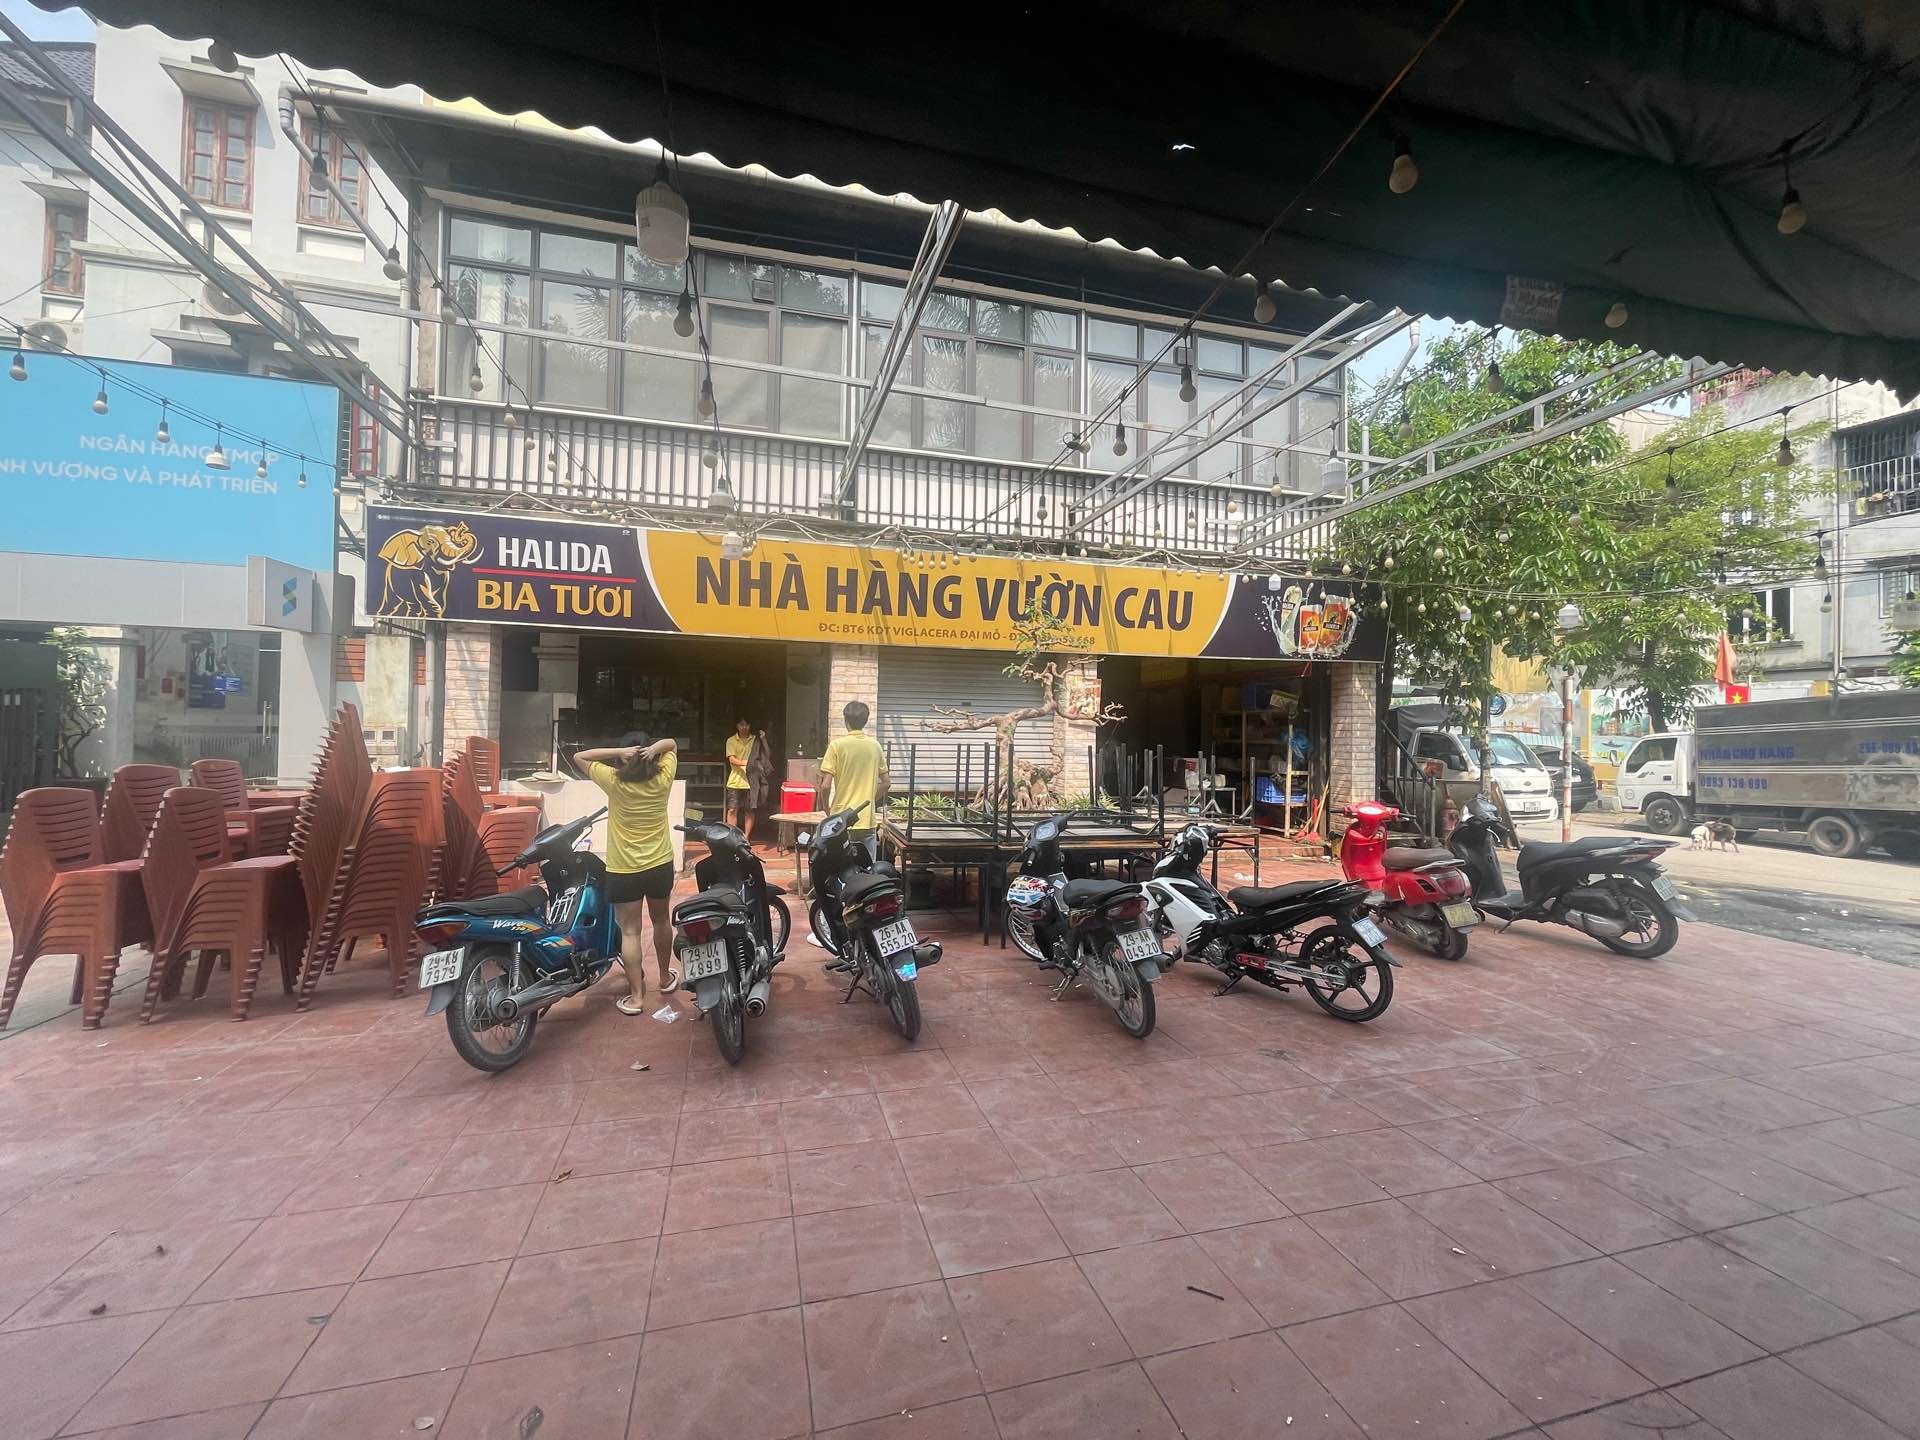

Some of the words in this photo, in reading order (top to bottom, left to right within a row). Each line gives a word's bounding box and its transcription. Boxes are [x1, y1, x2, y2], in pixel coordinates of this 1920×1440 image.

[80, 433, 145, 455] NGÂN
[32, 459, 118, 482] VƯỢNG
[123, 465, 153, 485] VÀ
[158, 470, 215, 489] PHÁT
[498, 536, 613, 574] HALIDA
[476, 580, 540, 612] BIA
[550, 584, 632, 618] TƯƠI
[696, 552, 810, 611] NHÀ
[825, 560, 963, 620] HÀNG
[976, 572, 1103, 627] VƯỜN
[1114, 587, 1194, 632] CAU
[842, 624, 865, 634] BT6
[893, 627, 958, 639] VIGLACERA
[960, 630, 980, 642] ĐẠI
[492, 919, 527, 929] Wave
[880, 932, 915, 954] 555.20
[1125, 942, 1159, 960] 049.20
[425, 965, 456, 985] 7979
